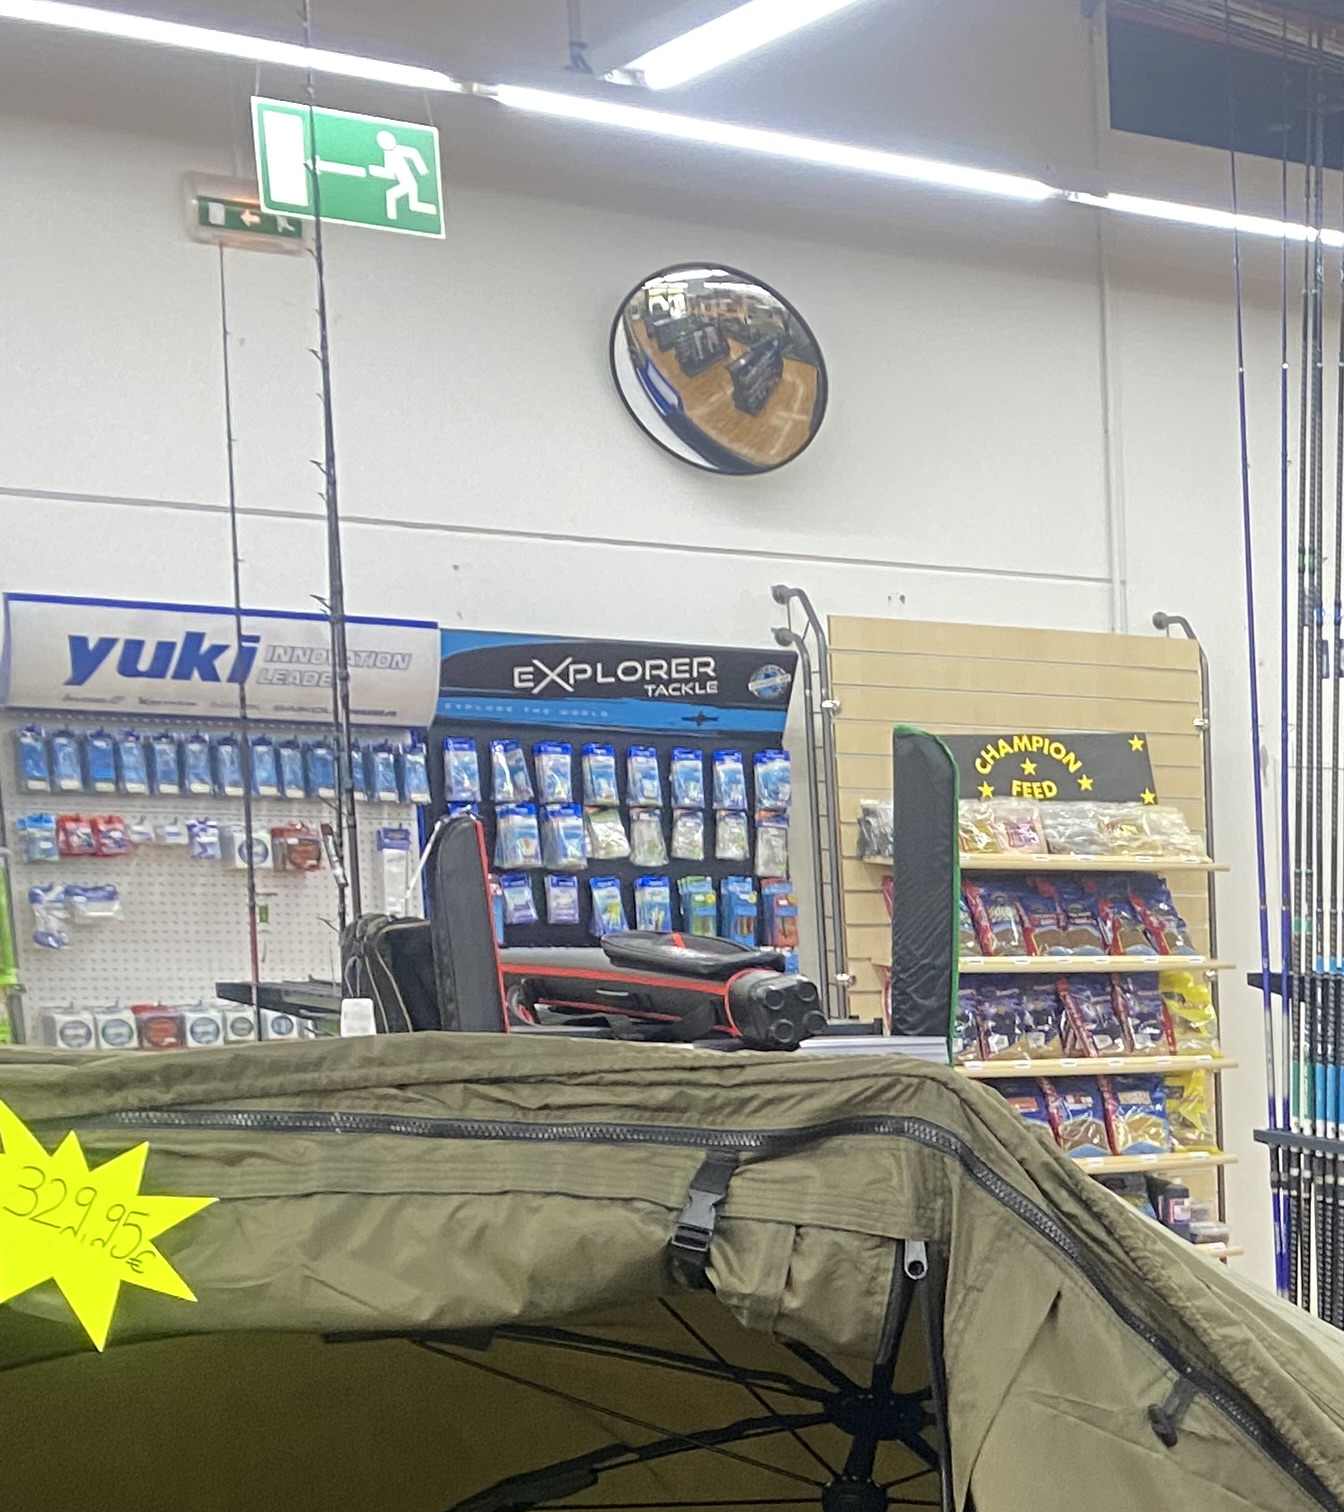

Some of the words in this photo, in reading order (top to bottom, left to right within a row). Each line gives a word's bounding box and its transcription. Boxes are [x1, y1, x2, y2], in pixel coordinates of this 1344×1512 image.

[64, 631, 261, 686] yuki
[255, 667, 346, 689] LEADE
[512, 656, 717, 695] EXPLORER
[643, 680, 719, 698] TACKLE
[975, 735, 1083, 774] CHAMPION
[1011, 779, 1058, 799] FEED
